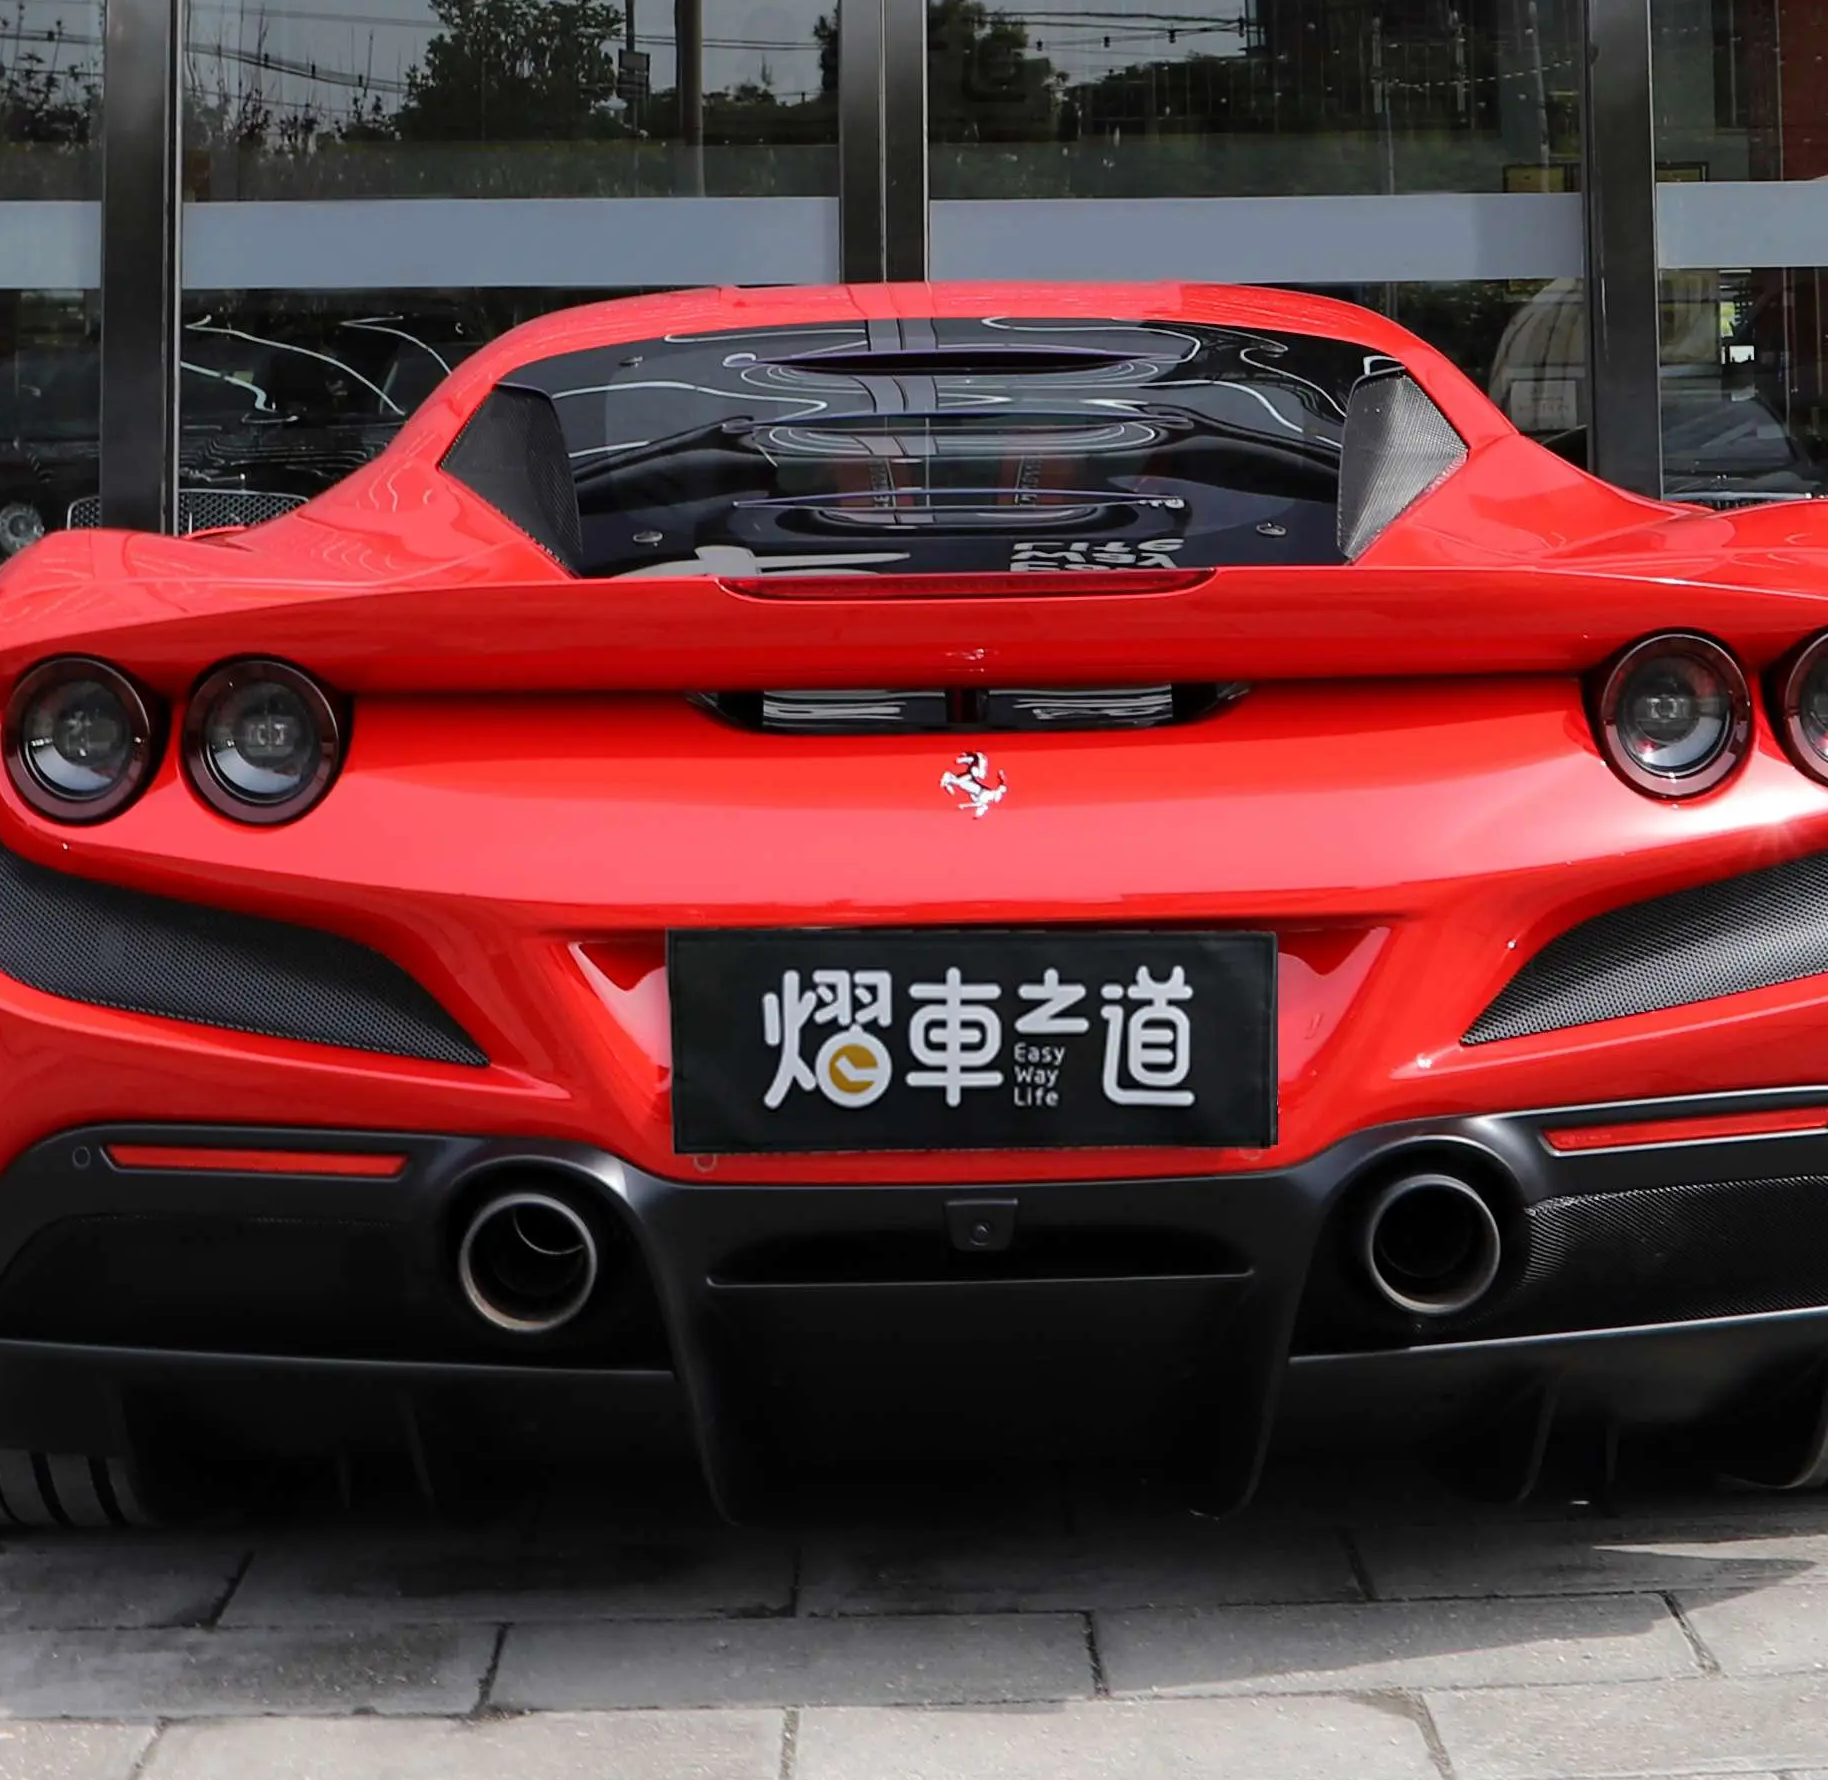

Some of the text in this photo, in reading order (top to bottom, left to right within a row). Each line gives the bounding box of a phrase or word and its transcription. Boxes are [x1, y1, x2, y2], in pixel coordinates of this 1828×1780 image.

[763, 965, 1195, 1108] 熠車之道
[1014, 1042, 1066, 1065] Easy
[1014, 1065, 1059, 1088] Way
[1014, 1087, 1059, 1107] Life
